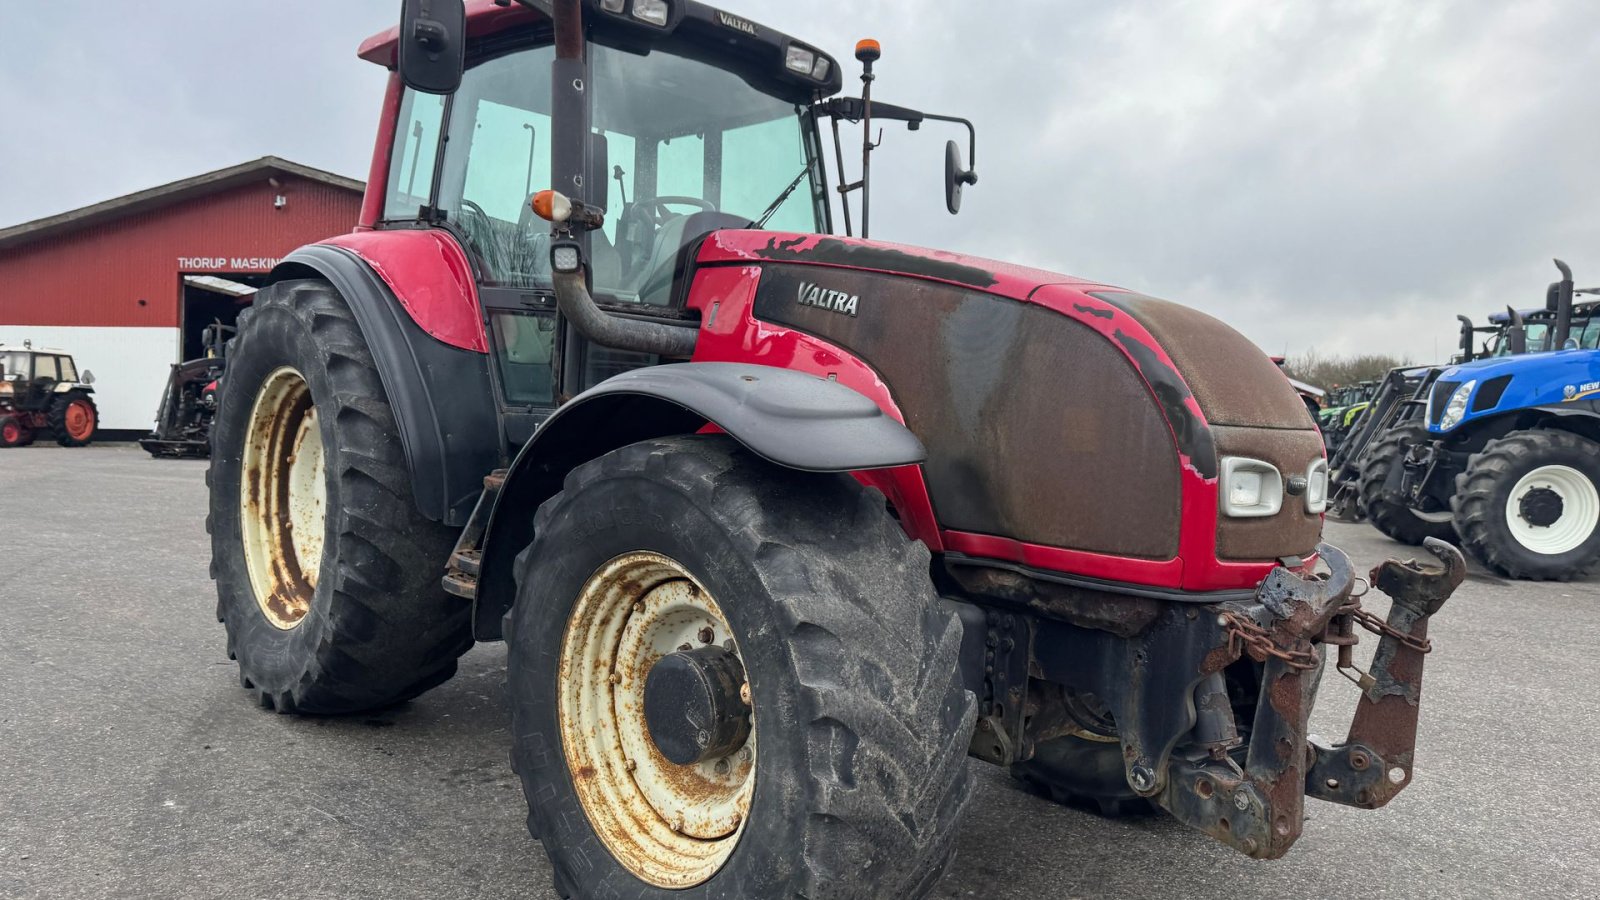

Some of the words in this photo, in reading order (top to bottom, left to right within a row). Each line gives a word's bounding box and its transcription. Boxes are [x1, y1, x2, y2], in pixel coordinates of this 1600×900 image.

[719, 11, 755, 34] VALTRA
[178, 257, 226, 269] THORUP
[230, 257, 282, 269] MASKIN
[797, 281, 859, 315] VALTRA
[1580, 381, 1600, 392] NEW
